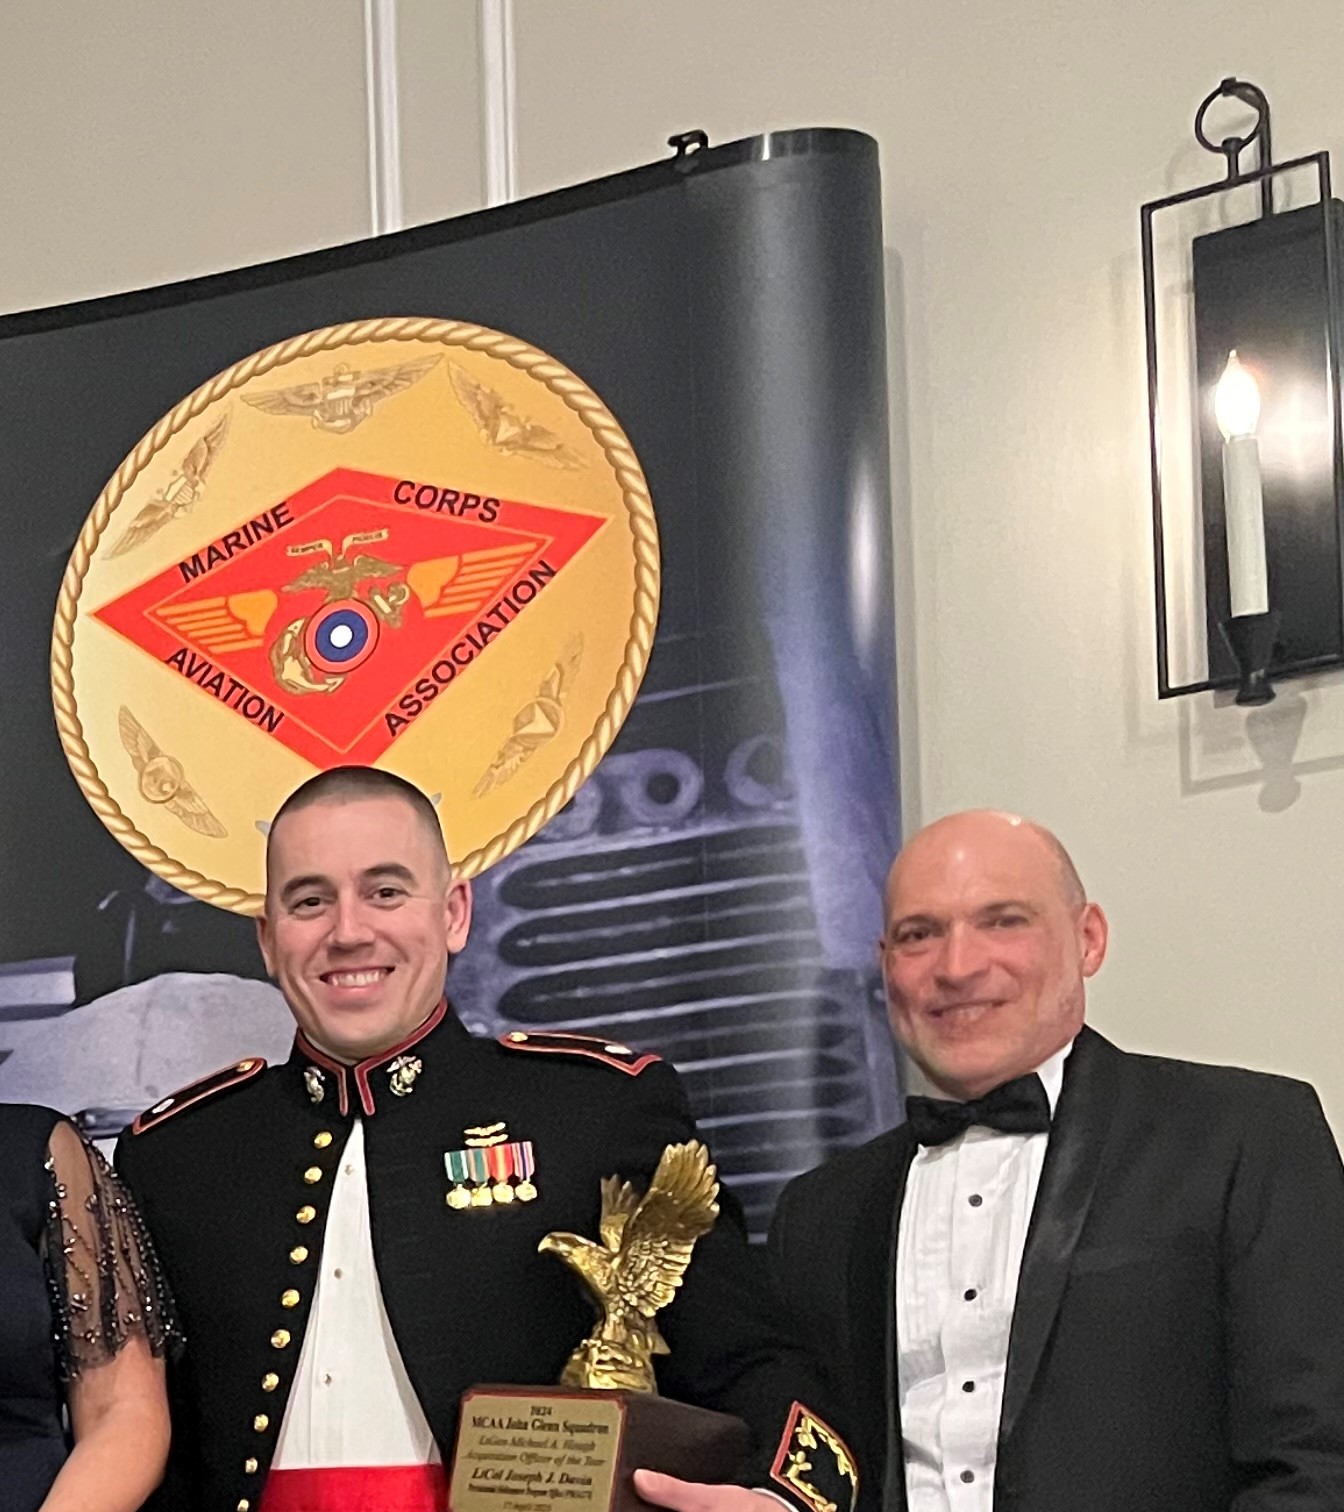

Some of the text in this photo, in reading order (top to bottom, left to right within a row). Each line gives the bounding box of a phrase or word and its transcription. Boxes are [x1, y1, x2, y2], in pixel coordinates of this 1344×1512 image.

[178, 480, 500, 583] MARINE CORPS
[165, 559, 558, 737] AVIATION ASSOCIATION
[472, 1416, 609, 1435] MCAA John Glenn Squadron
